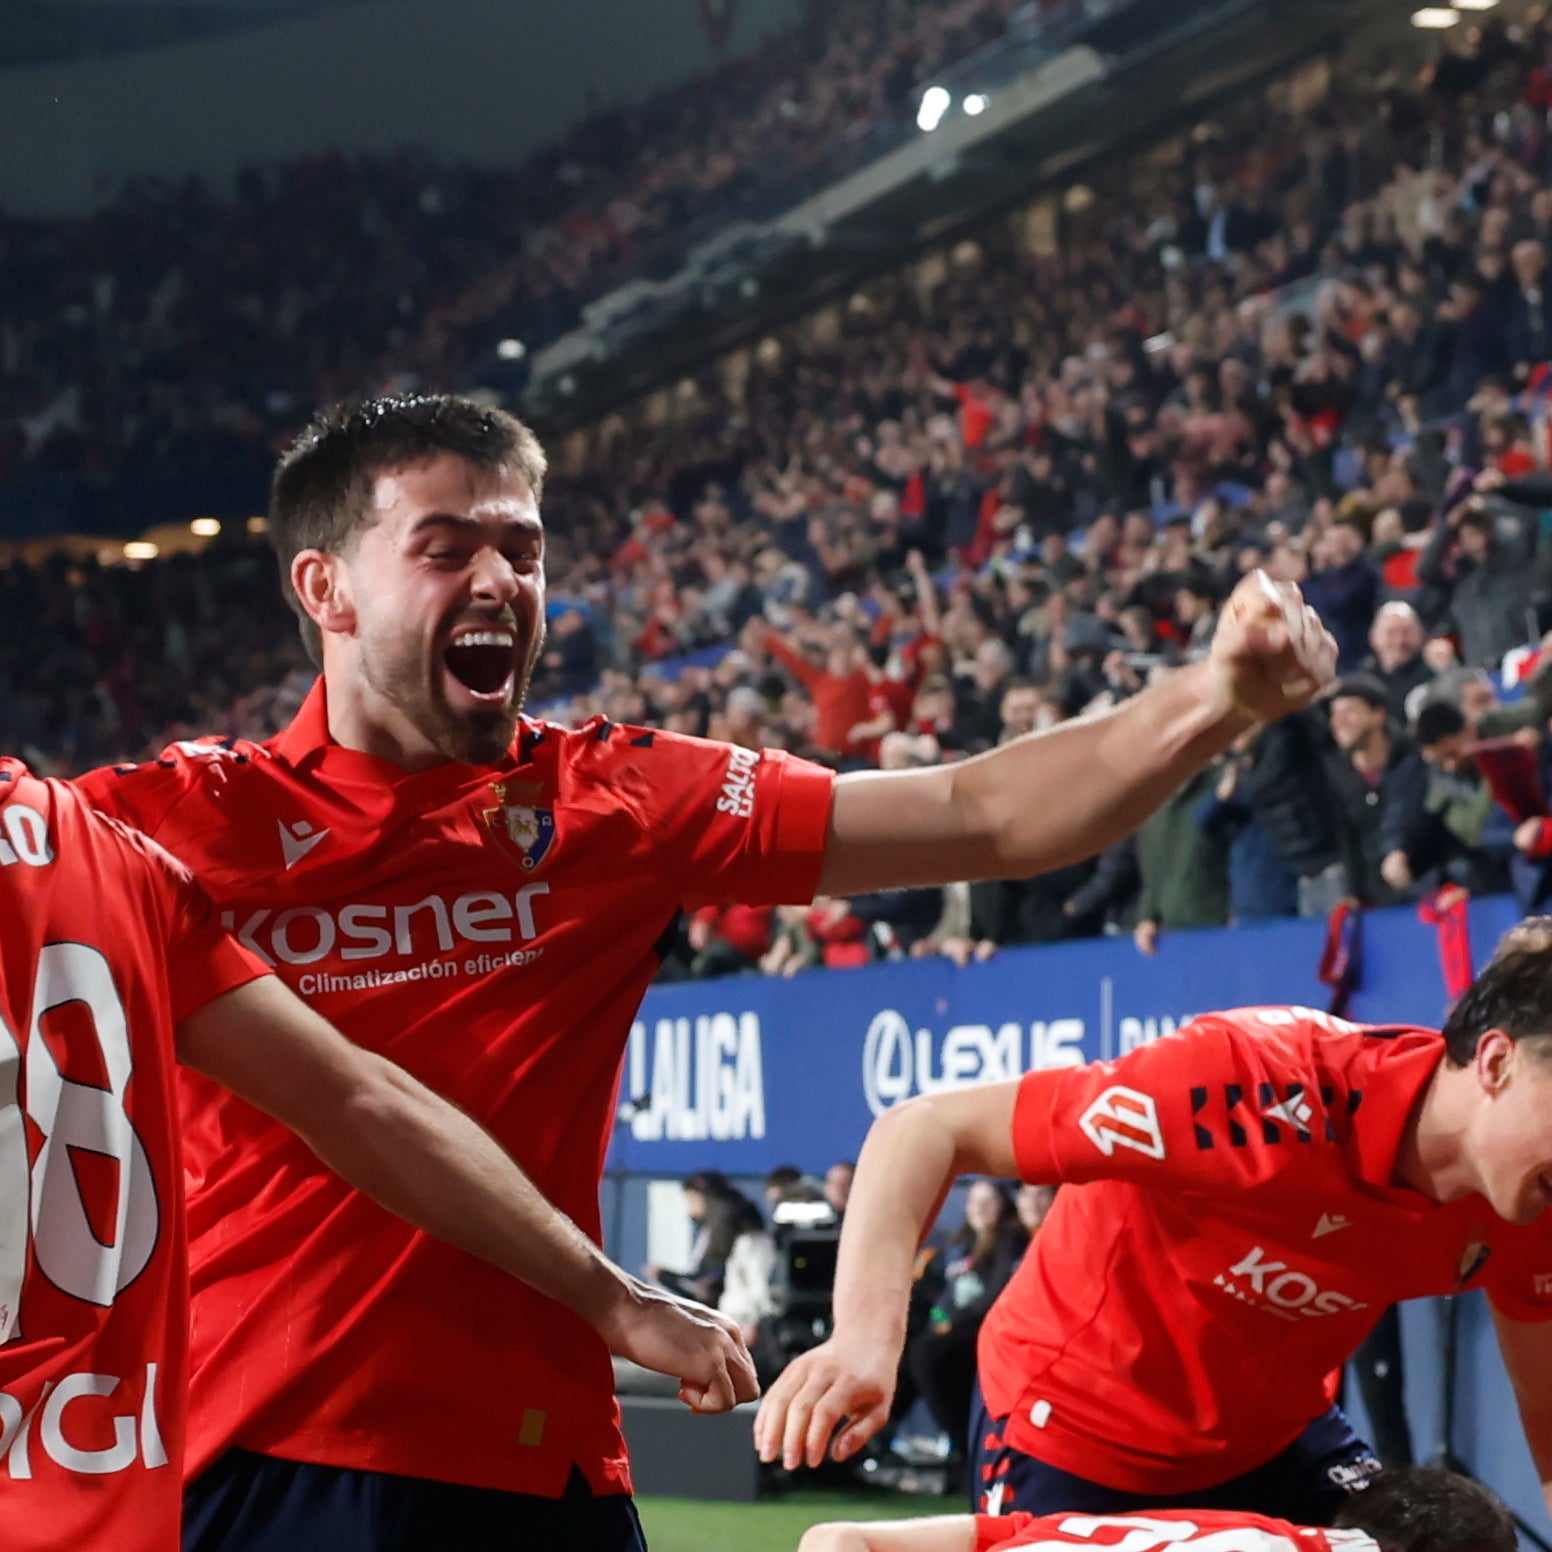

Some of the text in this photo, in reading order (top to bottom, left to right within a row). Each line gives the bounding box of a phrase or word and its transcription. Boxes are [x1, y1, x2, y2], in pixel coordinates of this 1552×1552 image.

[298, 957, 458, 996] Climatización
[628, 1010, 767, 1142] LALIGA
[913, 1018, 1088, 1097] LEXUS
